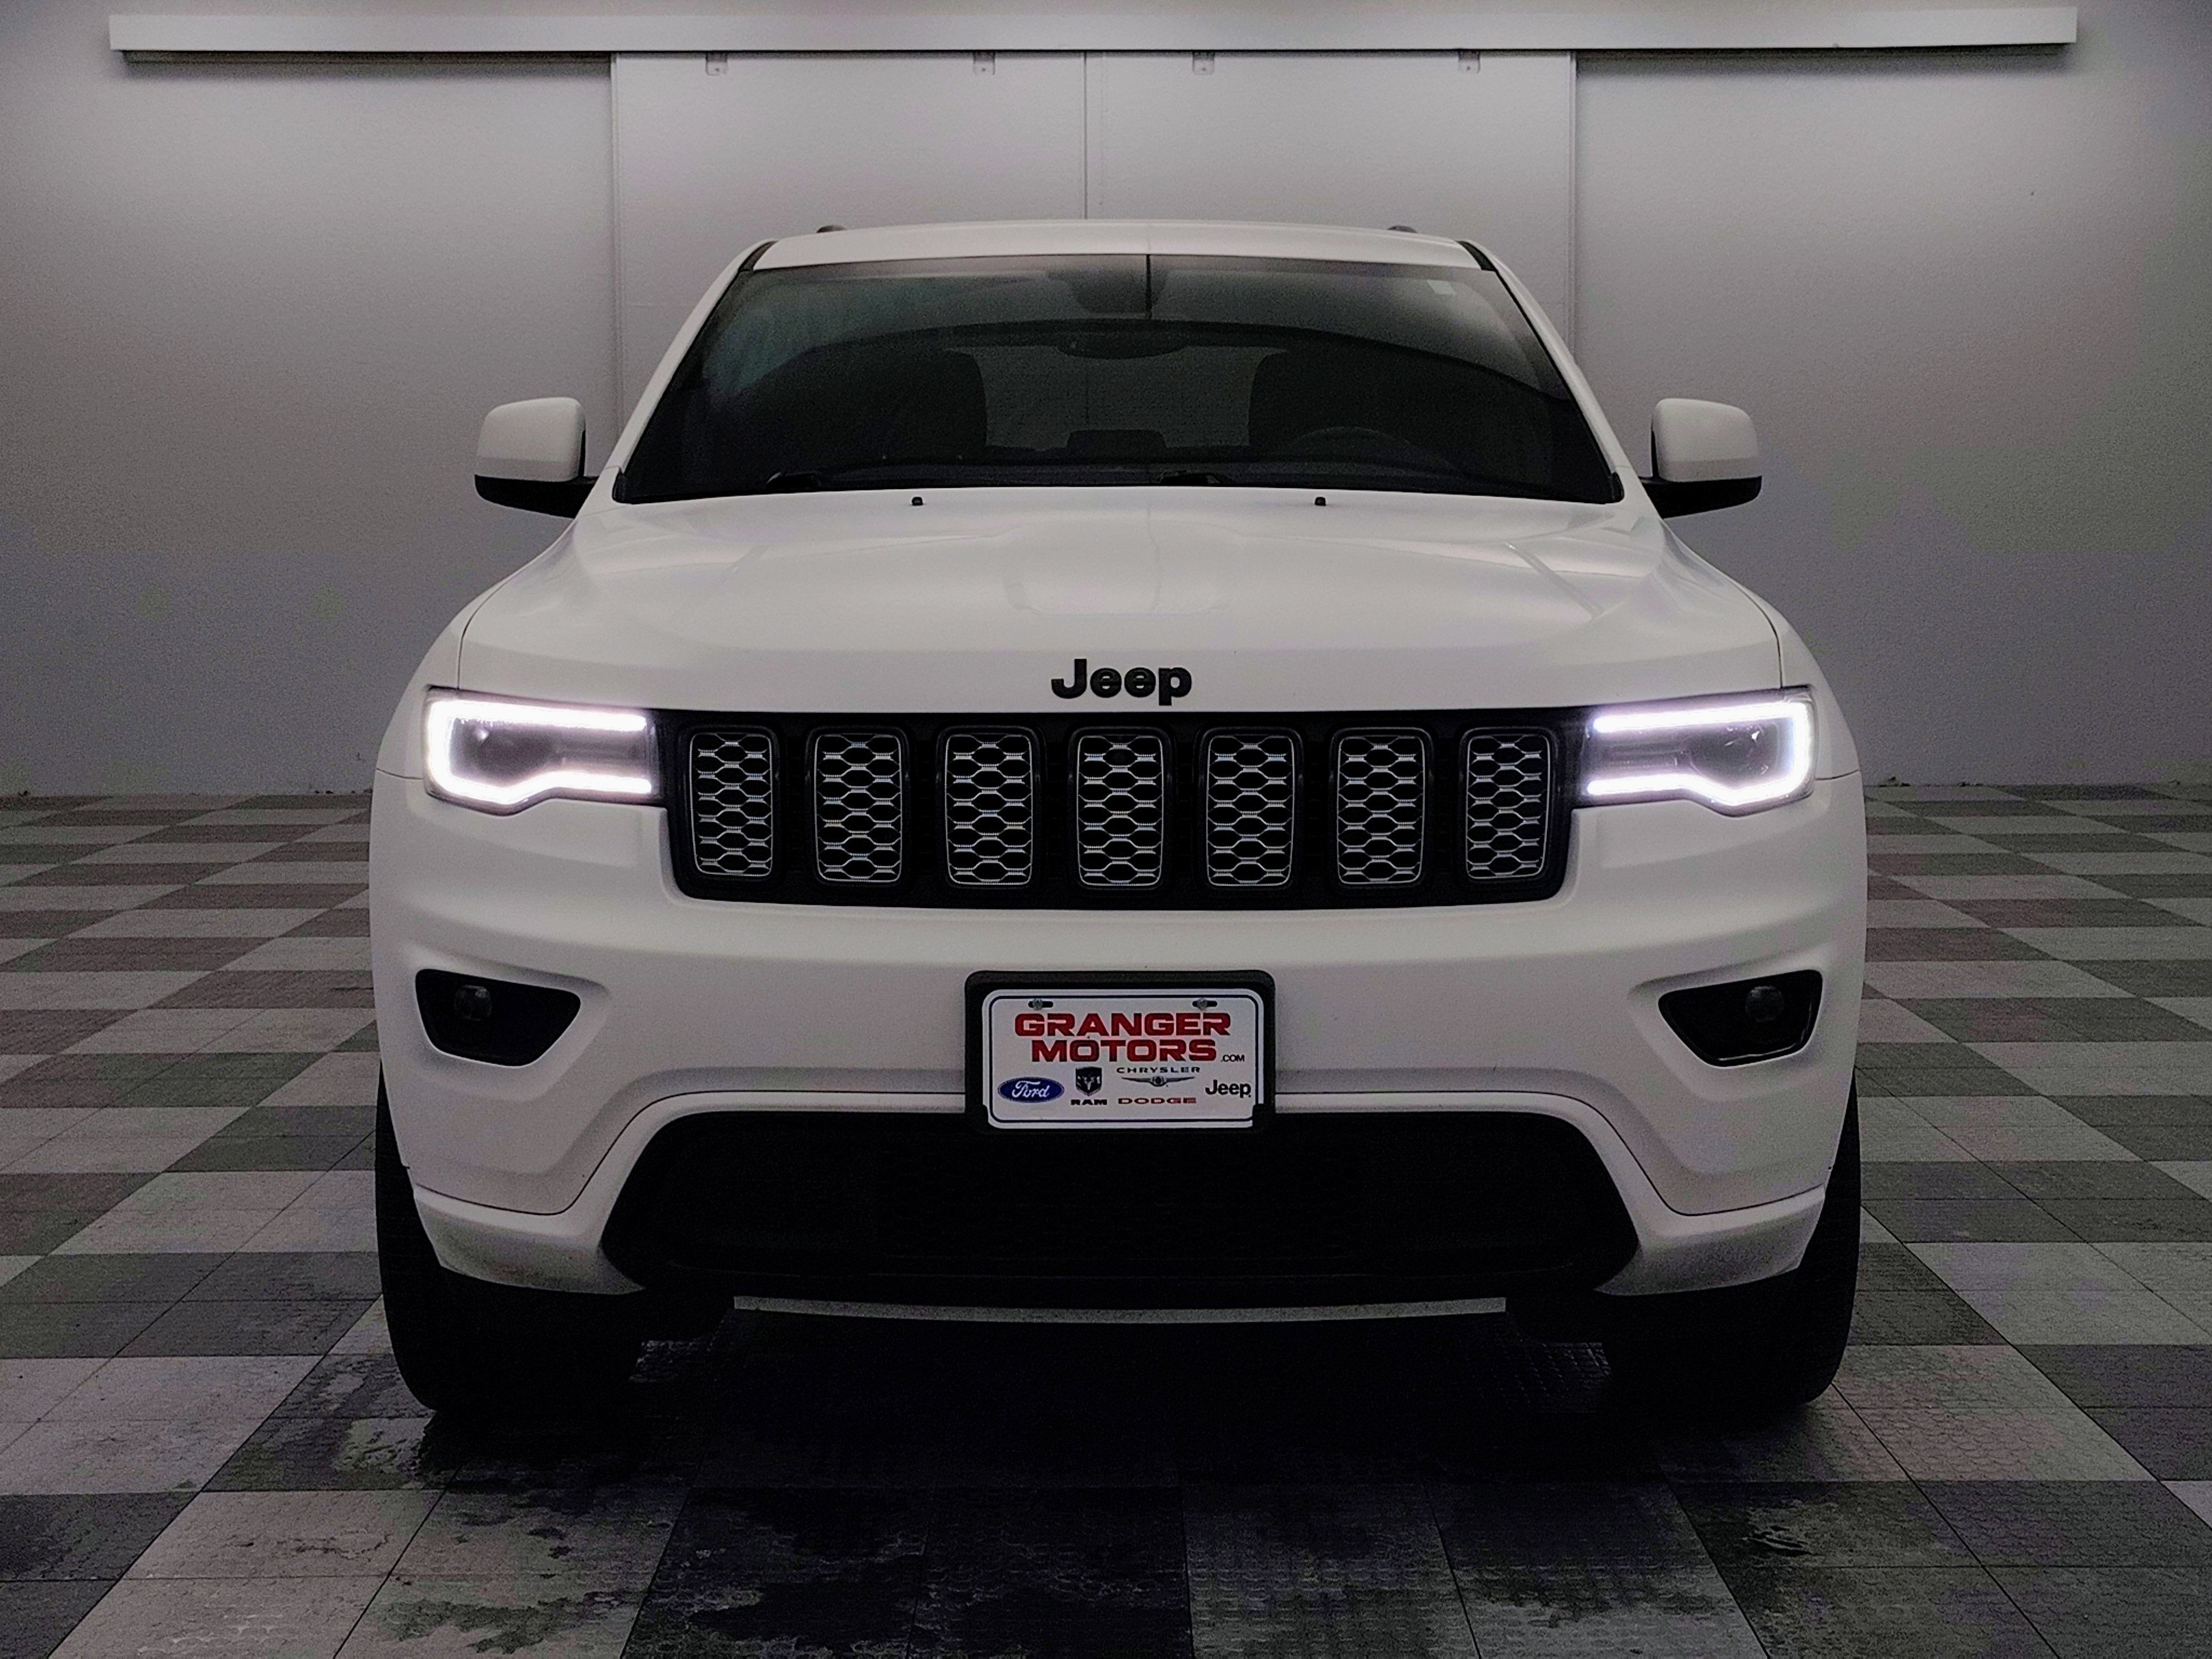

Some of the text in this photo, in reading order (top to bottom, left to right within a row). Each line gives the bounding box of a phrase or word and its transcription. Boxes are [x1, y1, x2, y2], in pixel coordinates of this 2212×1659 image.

[1051, 658, 1191, 705] Jeep
[1014, 1013, 1231, 1036] GRANGER
[1031, 1040, 1217, 1062] MOTORS
[1011, 1081, 1050, 1098] Ford
